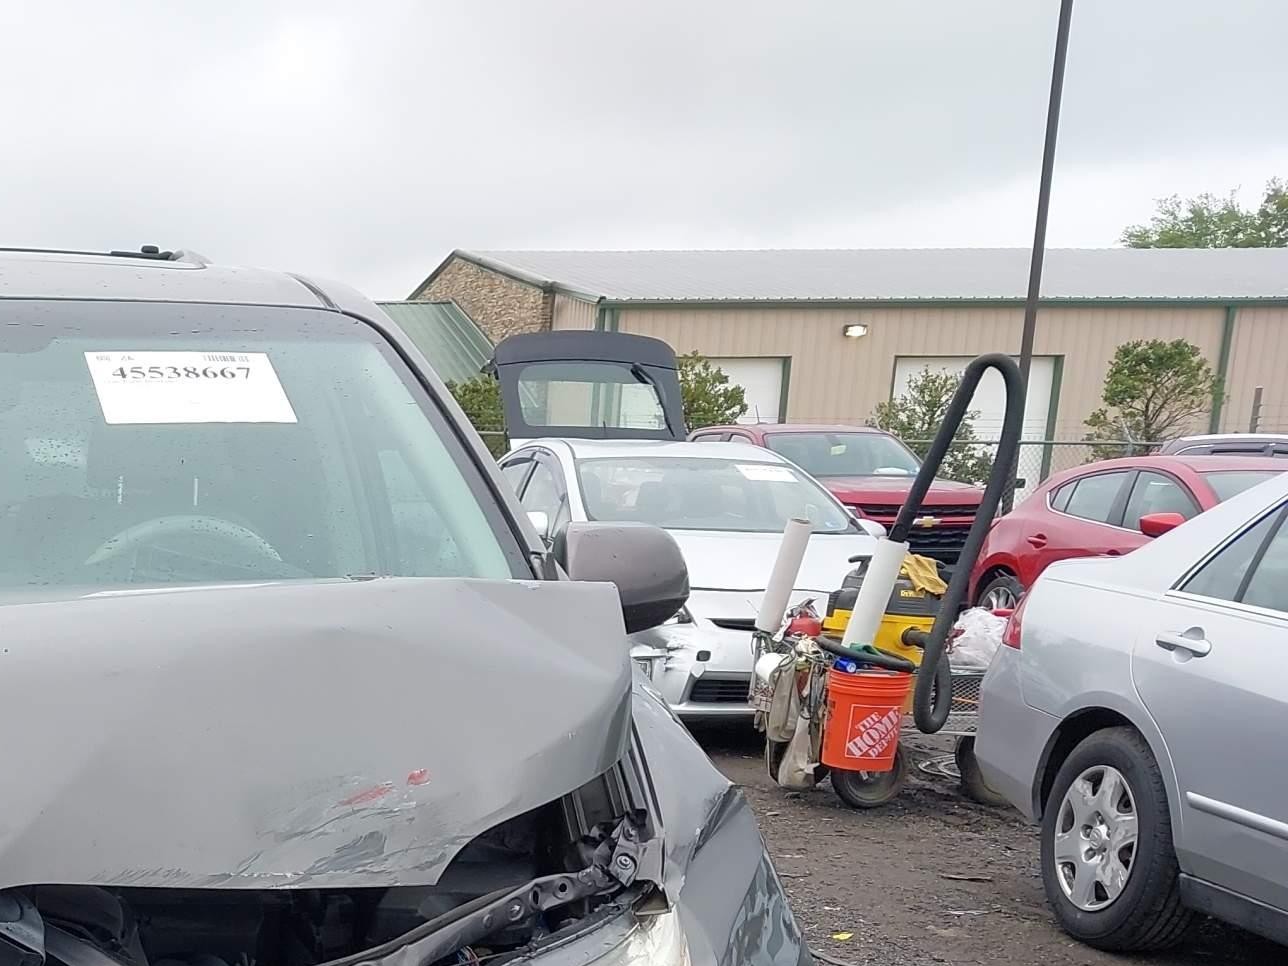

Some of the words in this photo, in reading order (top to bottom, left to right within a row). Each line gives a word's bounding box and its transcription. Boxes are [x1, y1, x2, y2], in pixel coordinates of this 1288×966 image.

[112, 366, 250, 380] 45538667
[847, 706, 902, 756] HOME
[855, 712, 881, 732] THE
